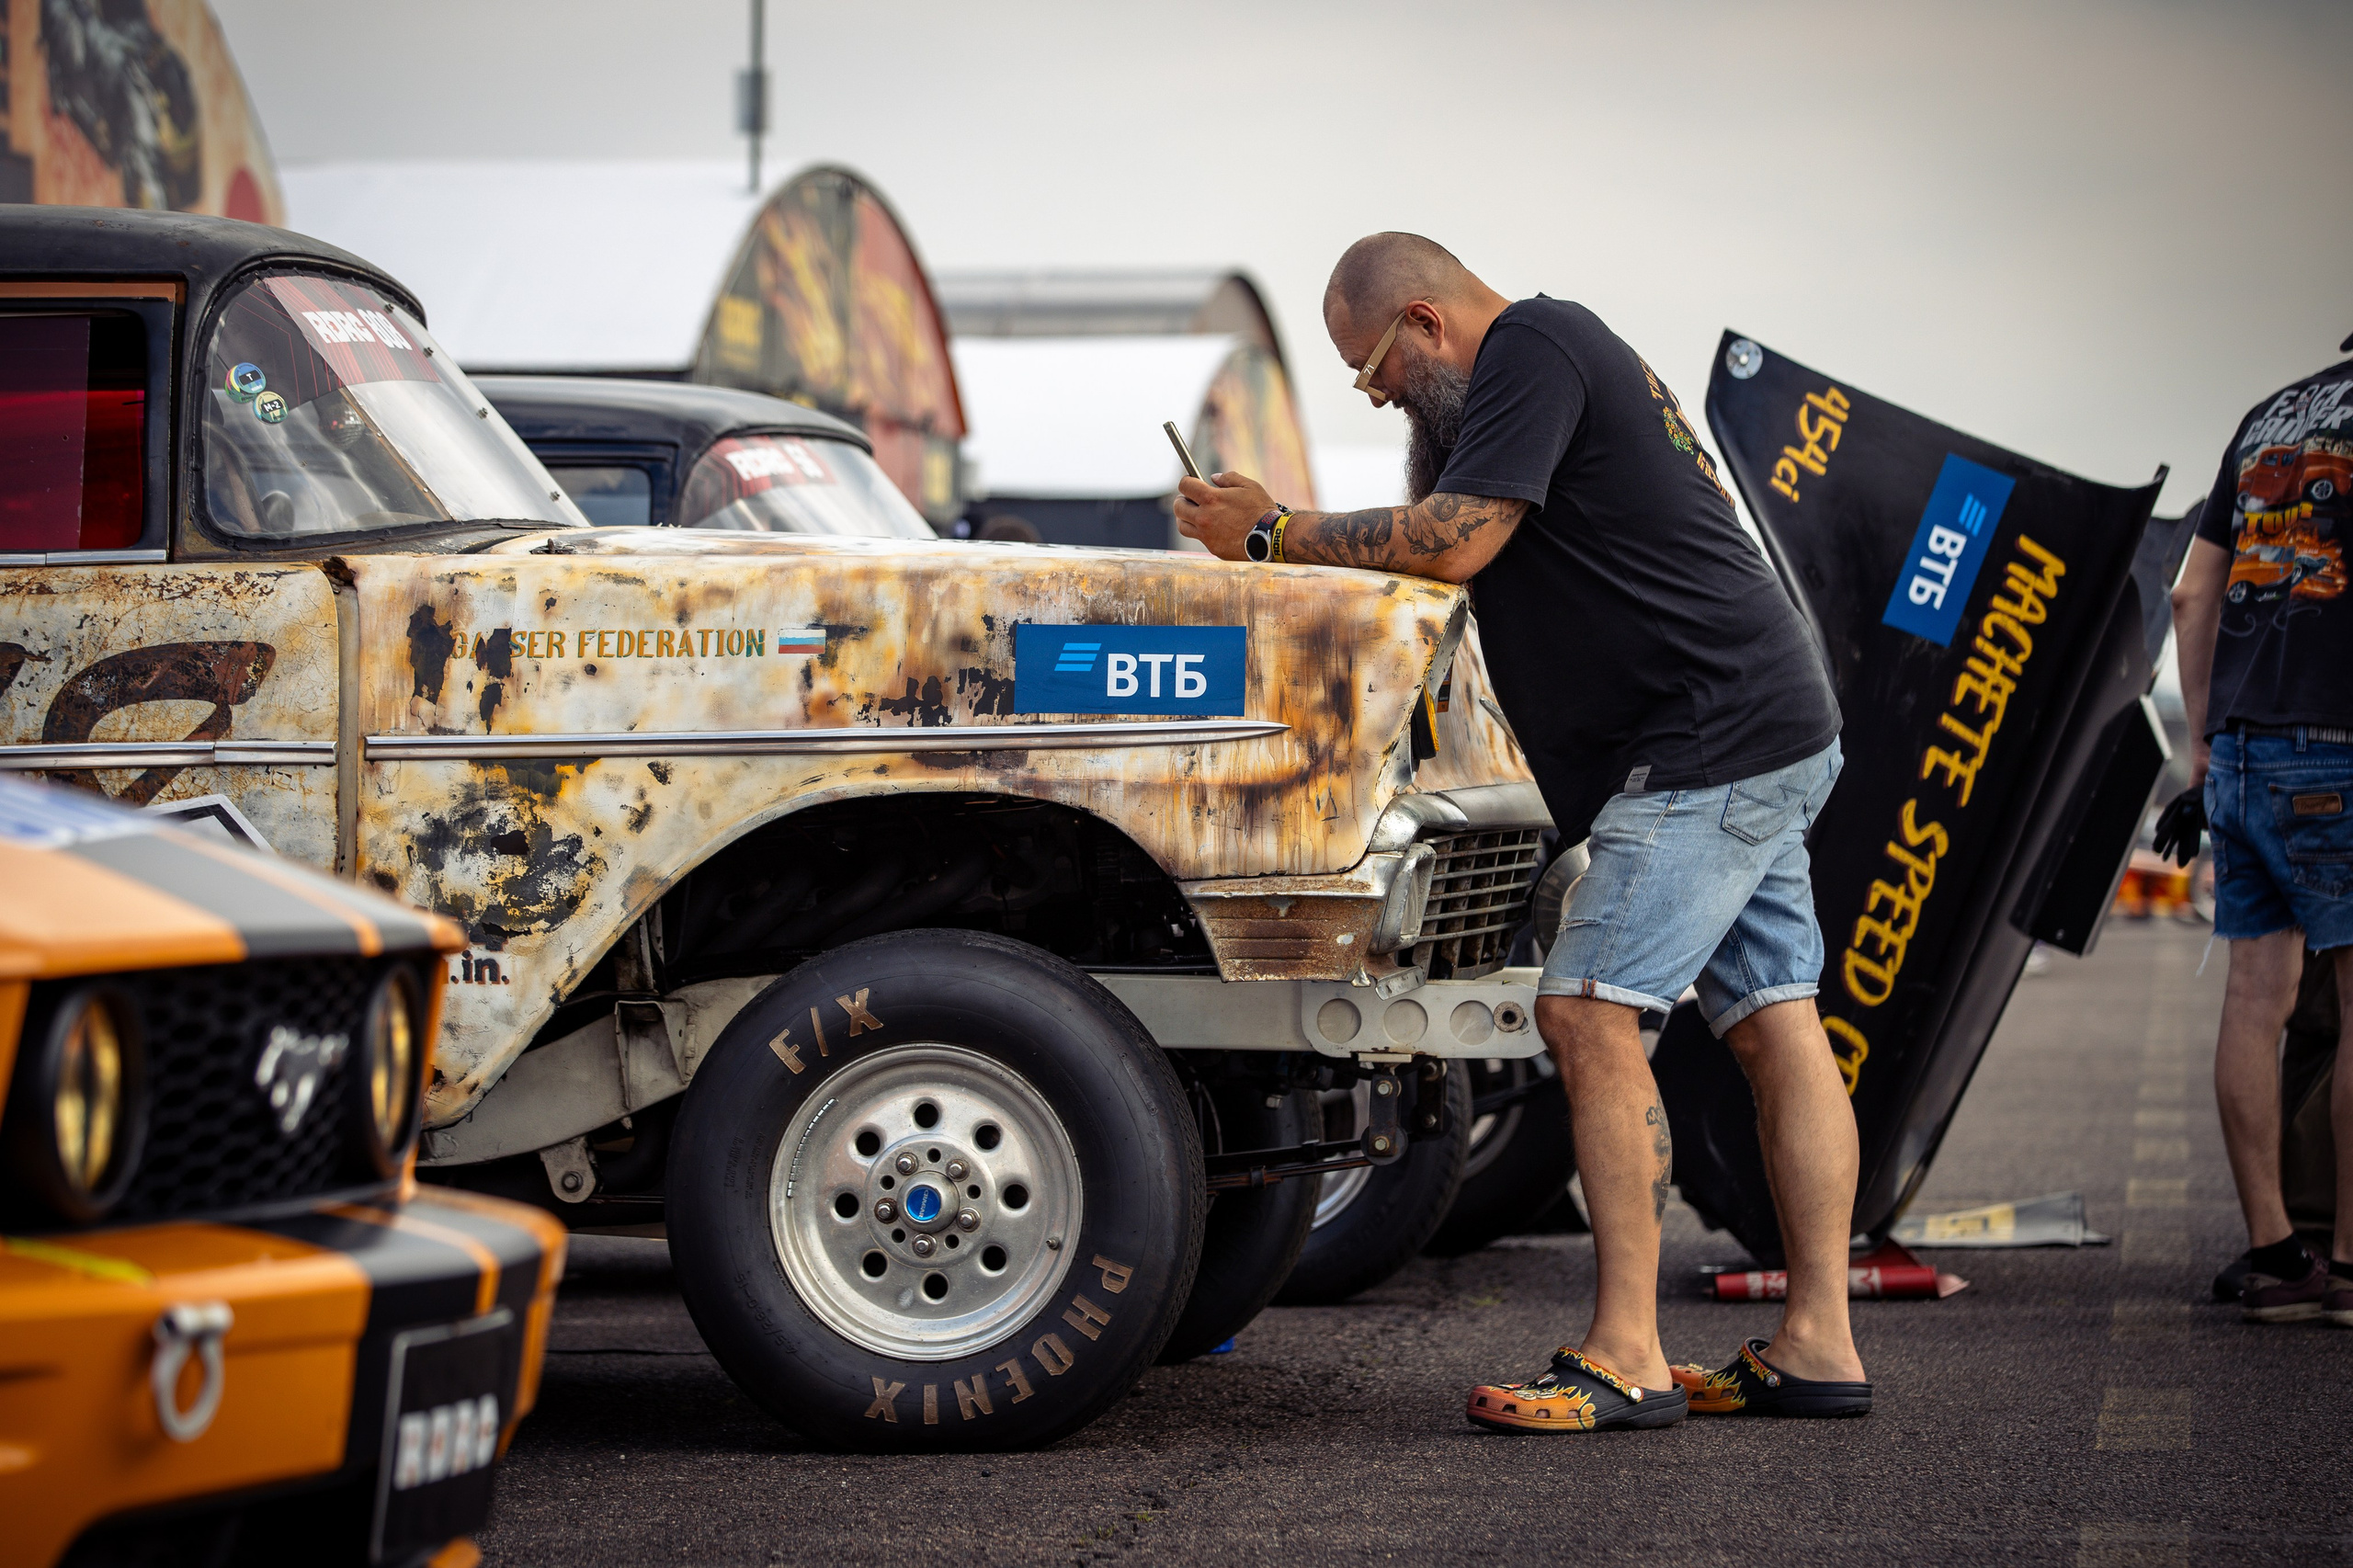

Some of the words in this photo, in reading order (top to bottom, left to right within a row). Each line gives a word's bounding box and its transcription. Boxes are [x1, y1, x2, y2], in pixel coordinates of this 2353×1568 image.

[301, 311, 376, 344] RDRC
[1768, 386, 1850, 504] 454ci
[1908, 524, 1967, 610] ВТБ
[577, 628, 766, 658] FEDERATION
[1107, 653, 1208, 699] ВТБ
[1919, 533, 2066, 808] MACHETE
[1841, 798, 1949, 1007] SPEED
[768, 987, 884, 1075] F/X
[864, 1254, 1133, 1425] PHOENIX
